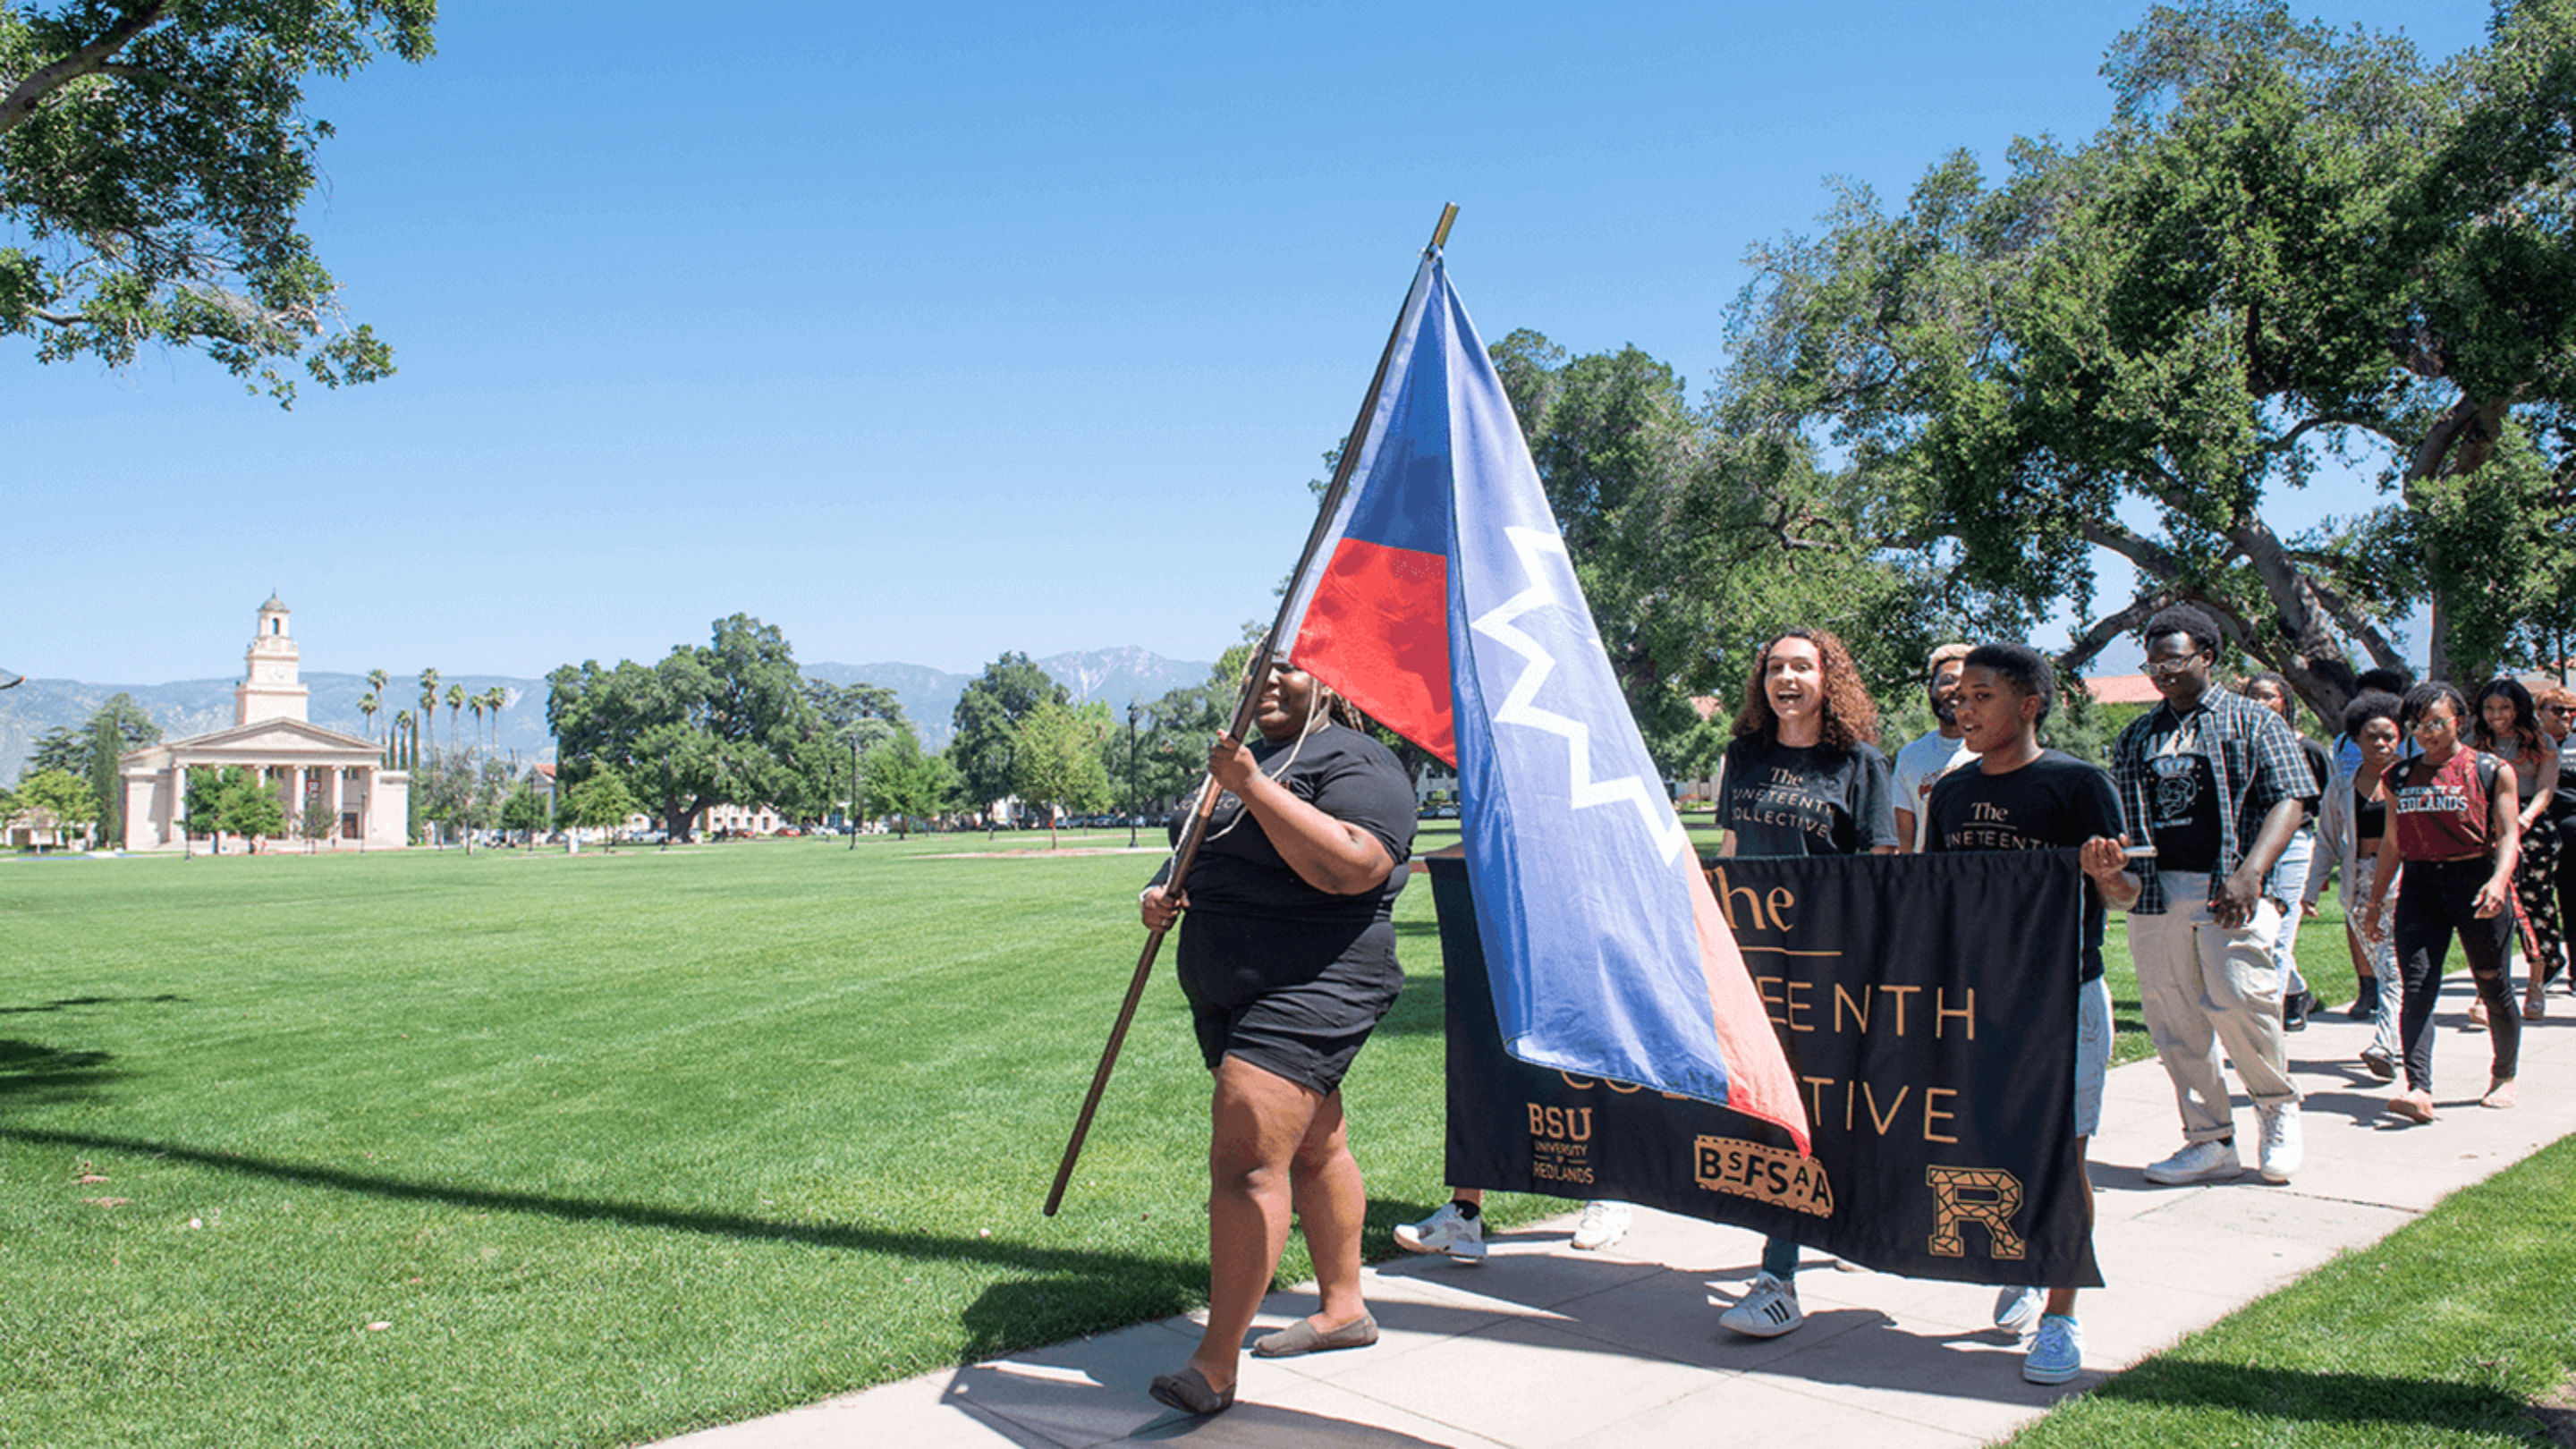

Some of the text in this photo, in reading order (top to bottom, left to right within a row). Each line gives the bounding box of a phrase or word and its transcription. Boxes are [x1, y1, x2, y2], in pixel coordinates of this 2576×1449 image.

[1770, 767, 1804, 786] The
[1970, 801, 2010, 821] The
[2395, 795, 2469, 814] EDLANDS
[1732, 806, 1829, 838] OLLECTIVE
[1756, 976, 1975, 1040] EENTH
[1527, 1102, 1592, 1141] BSU
[1533, 1161, 1595, 1184] REDLANDS
[1926, 1164, 2026, 1260] R
